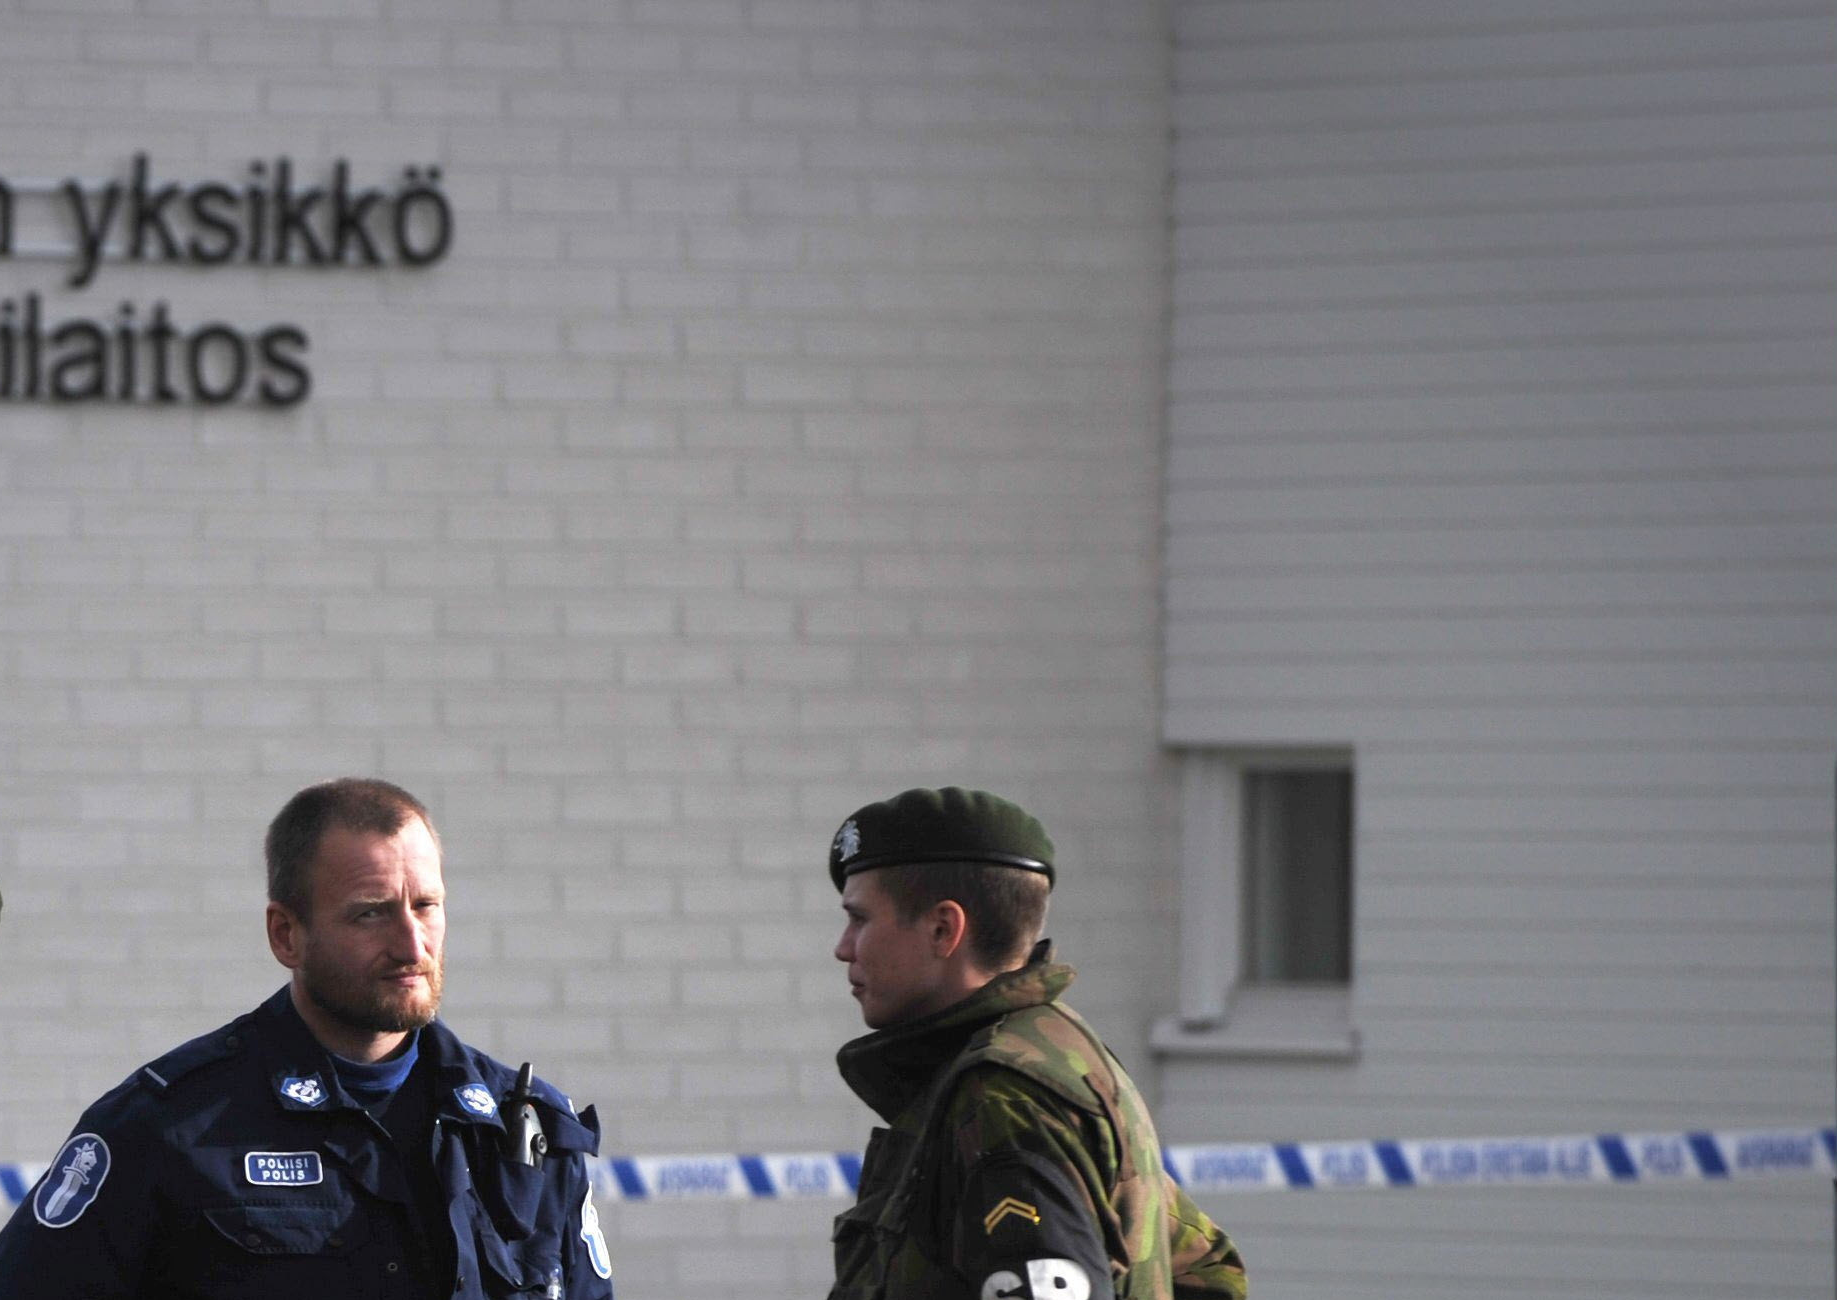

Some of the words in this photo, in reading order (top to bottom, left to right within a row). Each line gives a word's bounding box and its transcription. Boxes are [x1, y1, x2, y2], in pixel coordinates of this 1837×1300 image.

[61, 152, 455, 290] yksikkö
[257, 1157, 309, 1170] POLIISI
[262, 1169, 306, 1181] POLIS
